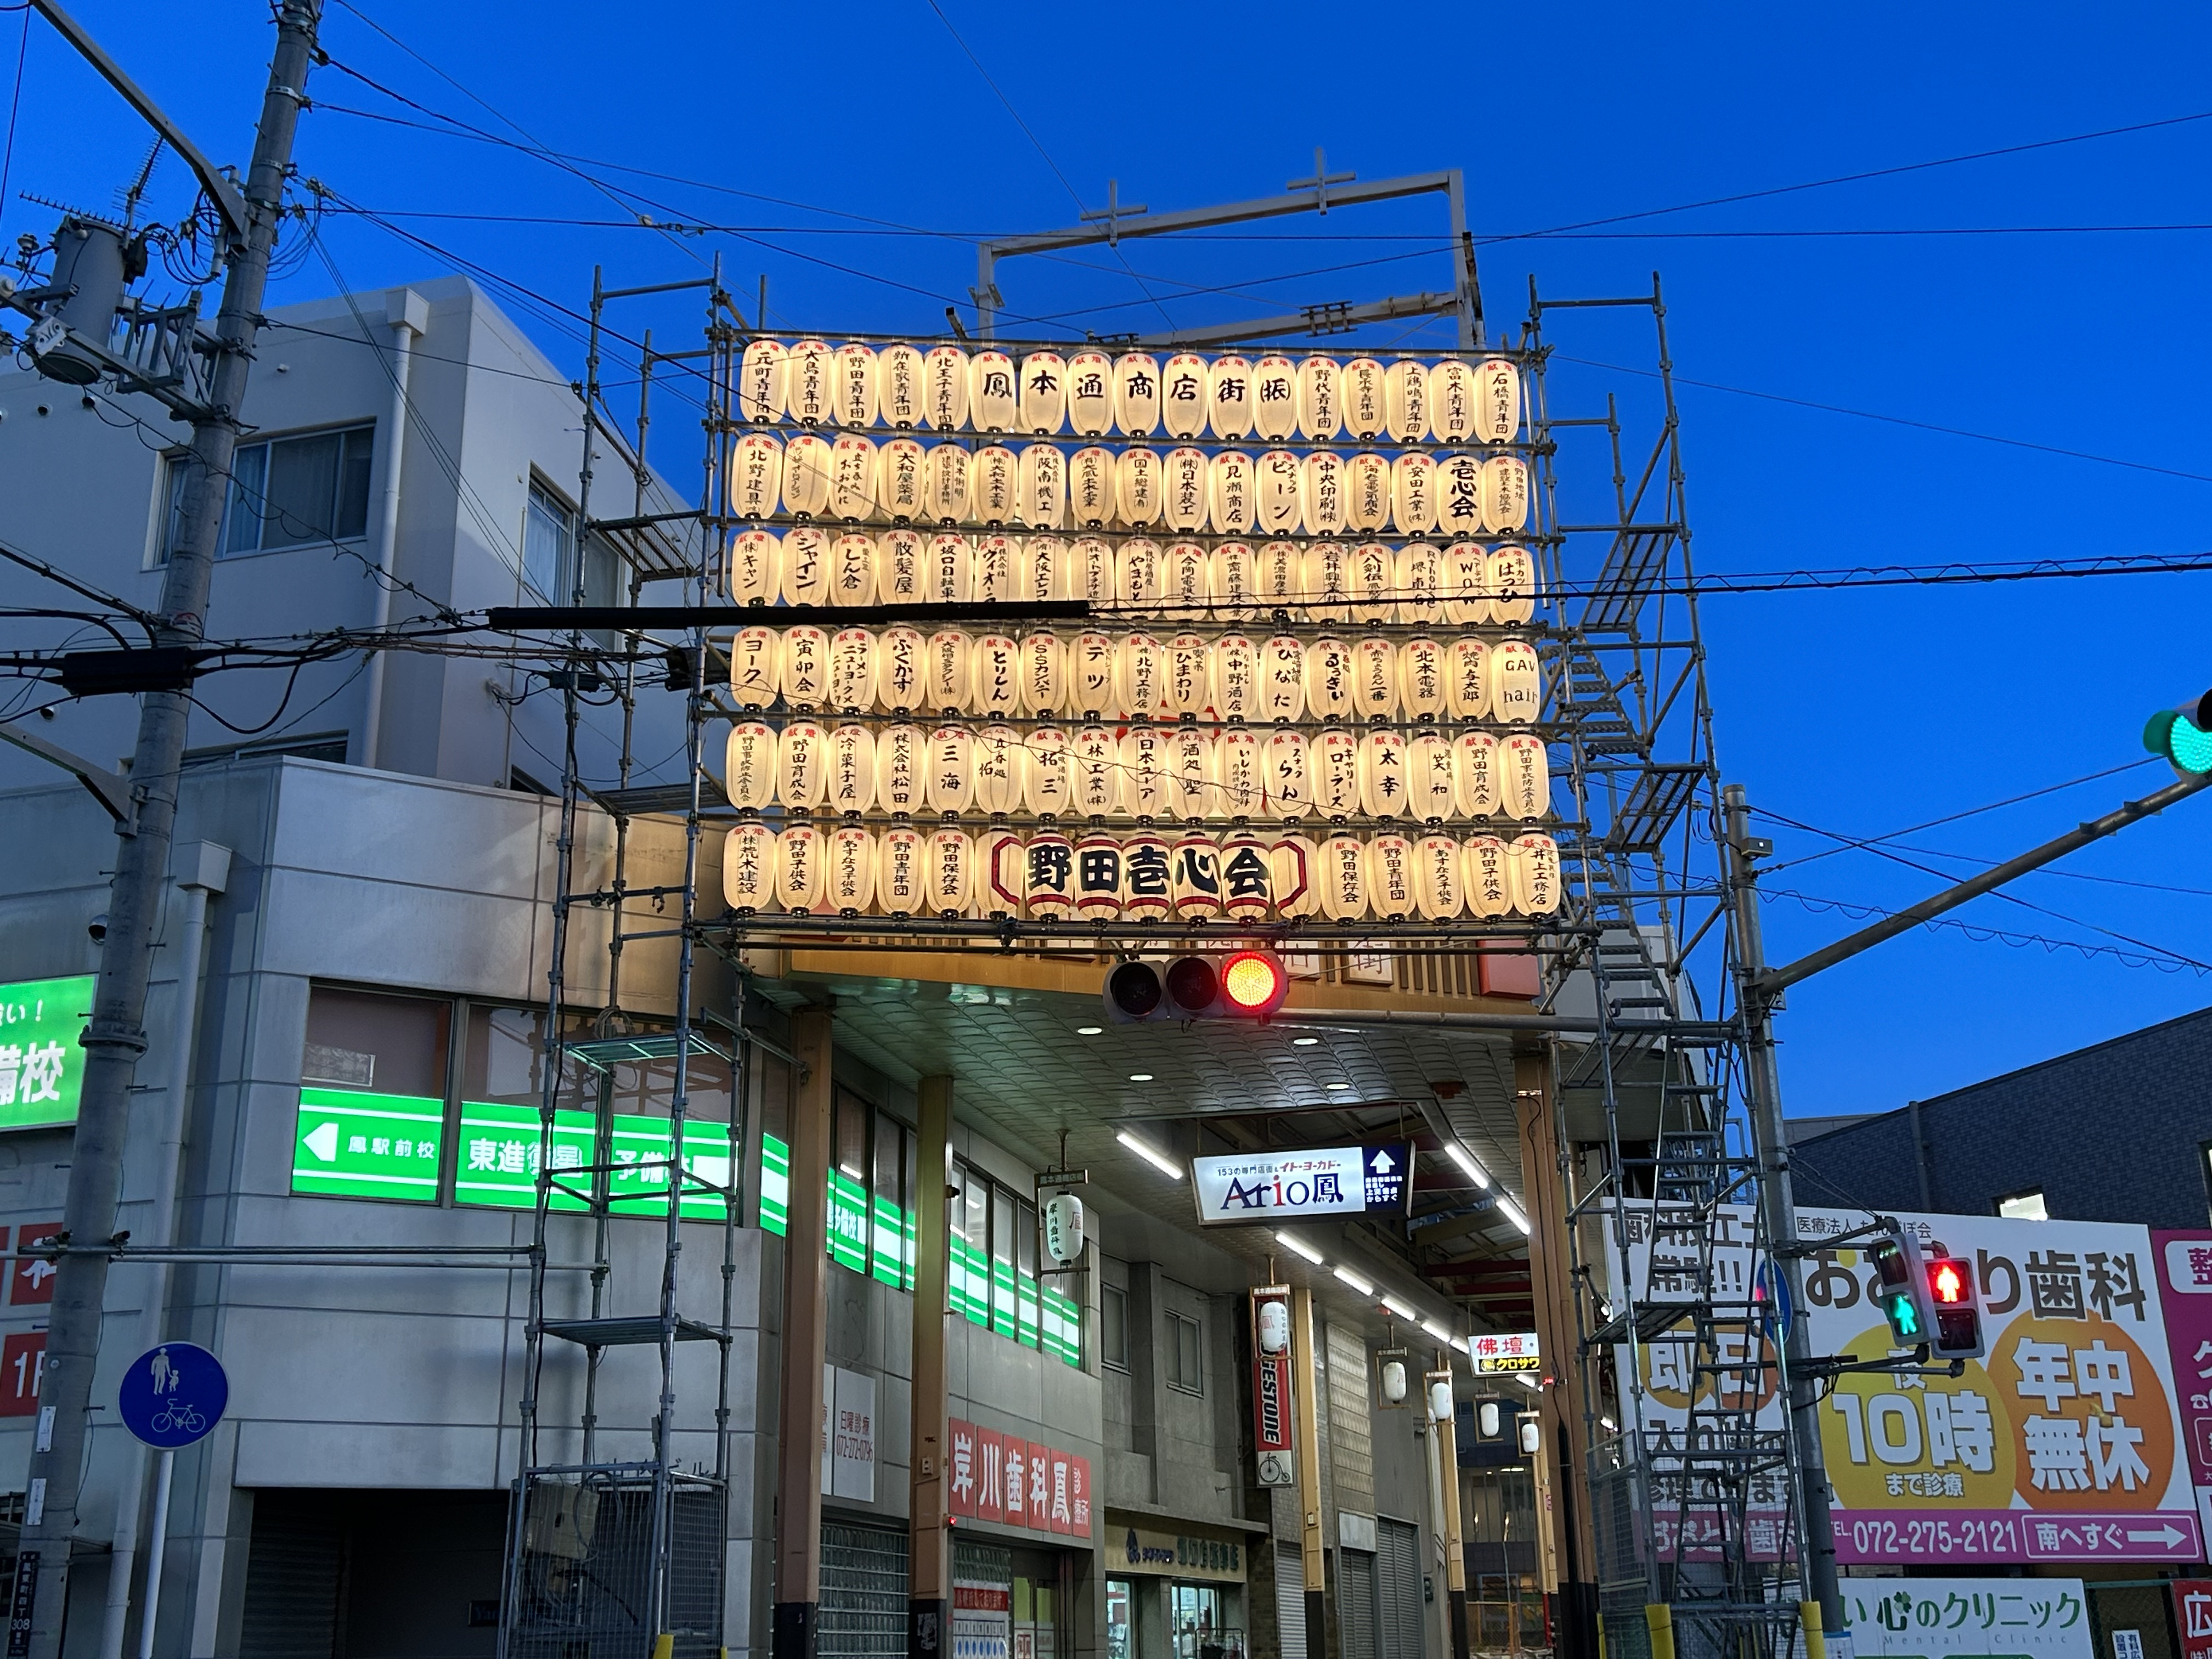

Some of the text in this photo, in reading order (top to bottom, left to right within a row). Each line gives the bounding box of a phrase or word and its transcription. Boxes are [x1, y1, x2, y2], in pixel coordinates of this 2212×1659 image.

[755, 352, 773, 414] 元町青年団
[803, 350, 821, 414] 大鳥青年団
[849, 356, 865, 419] 野田青年団
[893, 351, 911, 416] 新在家青年団
[935, 358, 954, 424] 北王子青年団
[1314, 369, 1331, 429] 野代青年団
[1447, 366, 1465, 431] 富木青年団
[1492, 373, 1510, 434] 石橋青年団
[896, 452, 917, 505] 大和屋薬局
[1037, 457, 1053, 512] 阪南機工
[1272, 461, 1291, 520] ビーン
[1287, 463, 1297, 494] スナック
[1449, 459, 1478, 518] 壱心会
[796, 537, 818, 590] シャイン
[894, 541, 915, 594] 散髪屋
[1128, 555, 1145, 602] やまもと
[742, 639, 763, 684] ヨーク
[795, 639, 816, 693] 寅卯会
[855, 642, 867, 679] ラーメン
[991, 650, 1009, 701] とりしん
[1086, 646, 1105, 690] テツ
[1176, 652, 1193, 703] ひまわり
[1192, 648, 1205, 673] 喫茶
[1273, 648, 1294, 708] ひなた
[1414, 650, 1437, 699] 北本電器
[788, 738, 810, 801] 野田育成会
[838, 737, 857, 800] 冷菓子屋
[890, 732, 911, 804] 株式会社松田
[940, 744, 962, 791] 三海
[1182, 743, 1202, 771] 酒処
[1239, 749, 1251, 808] いしかわ内科
[1279, 759, 1299, 802] らん
[1292, 748, 1303, 779] スナック
[1330, 752, 1347, 808] ローラーズ
[1344, 748, 1354, 789] キャリー
[1378, 747, 1400, 798] 太幸
[1471, 748, 1490, 805] 野田育成会
[788, 839, 808, 891] 野田子供会
[840, 839, 858, 898] あすなろ子供会
[893, 841, 912, 896] 野田青年団
[940, 843, 961, 896] 野田保存会
[1028, 844, 1271, 898] 野田壱心会
[1340, 849, 1361, 904] 野田保存会
[1384, 848, 1406, 901] 野田青年団
[1434, 849, 1454, 906] あすなろ子供会
[1479, 847, 1503, 901] 野田子供会
[1530, 849, 1550, 905] 井上工務店
[348, 1135, 437, 1160] 鳳駅前校
[1220, 1173, 1344, 1211] Ario鳳
[1476, 1336, 1525, 1357] 佛壇
[1497, 1357, 1541, 1370] クロサワ
[2012, 1336, 2134, 1413] 年中
[840, 1409, 871, 1436] 日曜診療
[1831, 1390, 1995, 1472] 10時
[951, 1432, 1070, 1526] 岸川歯科鳳
[2022, 1414, 2151, 1492] 無休
[1886, 1472, 1965, 1498] まで診療
[1853, 1520, 2018, 1554] 072-275-2121
[2034, 1522, 2124, 1552] 南へすぐ
[10, 1618, 31, 1632] 308
[1883, 1634, 2067, 1645] Mental Clinic
